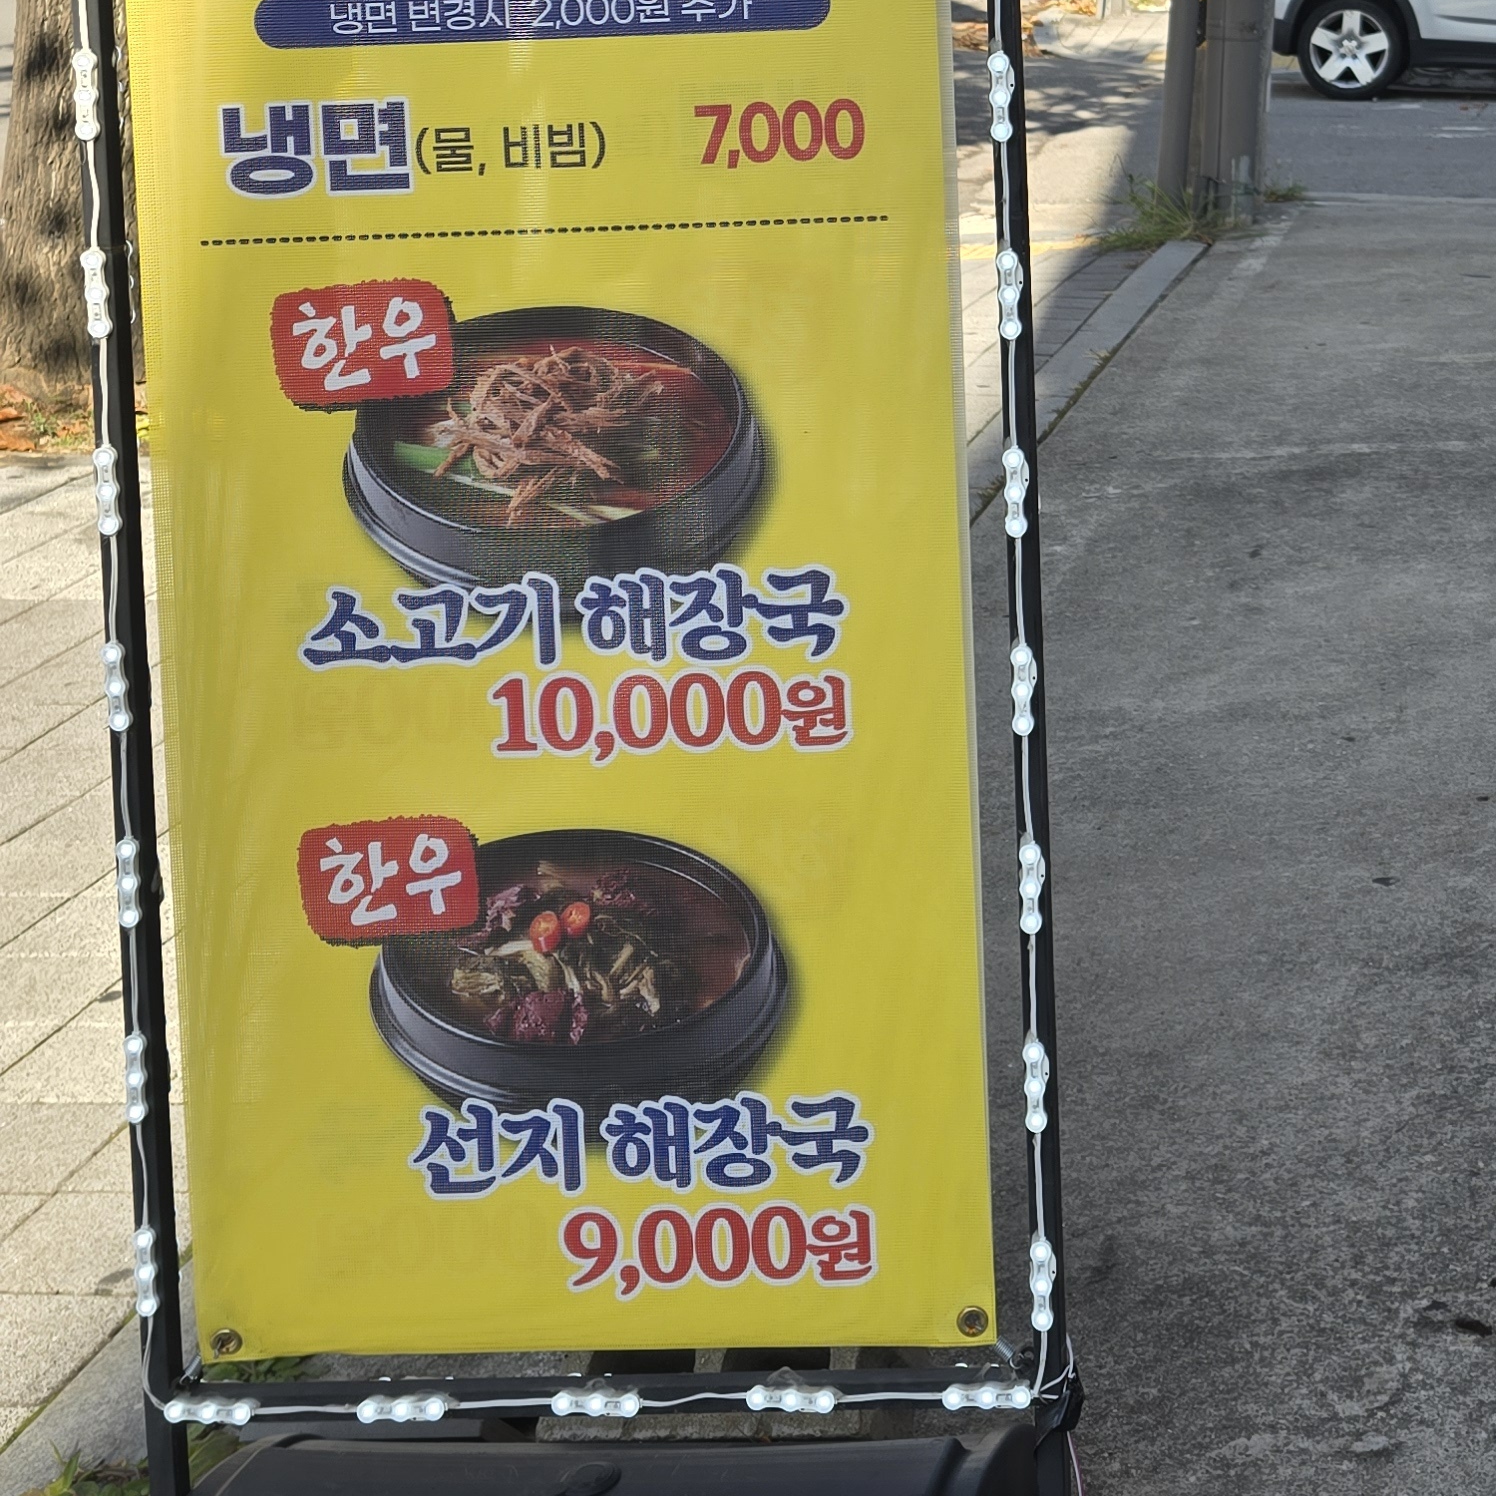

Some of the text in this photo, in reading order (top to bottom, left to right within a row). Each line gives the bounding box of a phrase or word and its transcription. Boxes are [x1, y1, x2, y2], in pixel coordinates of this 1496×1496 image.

[329, 0, 398, 36] 냉면
[694, 98, 864, 171] 7,000
[292, 296, 437, 392] 한우
[299, 563, 849, 672] 소고기 해장국
[490, 668, 852, 764] 10,000원
[320, 831, 463, 928] 한우
[409, 1091, 874, 1200] 선지 해장국
[559, 1200, 876, 1300] 9,000원
